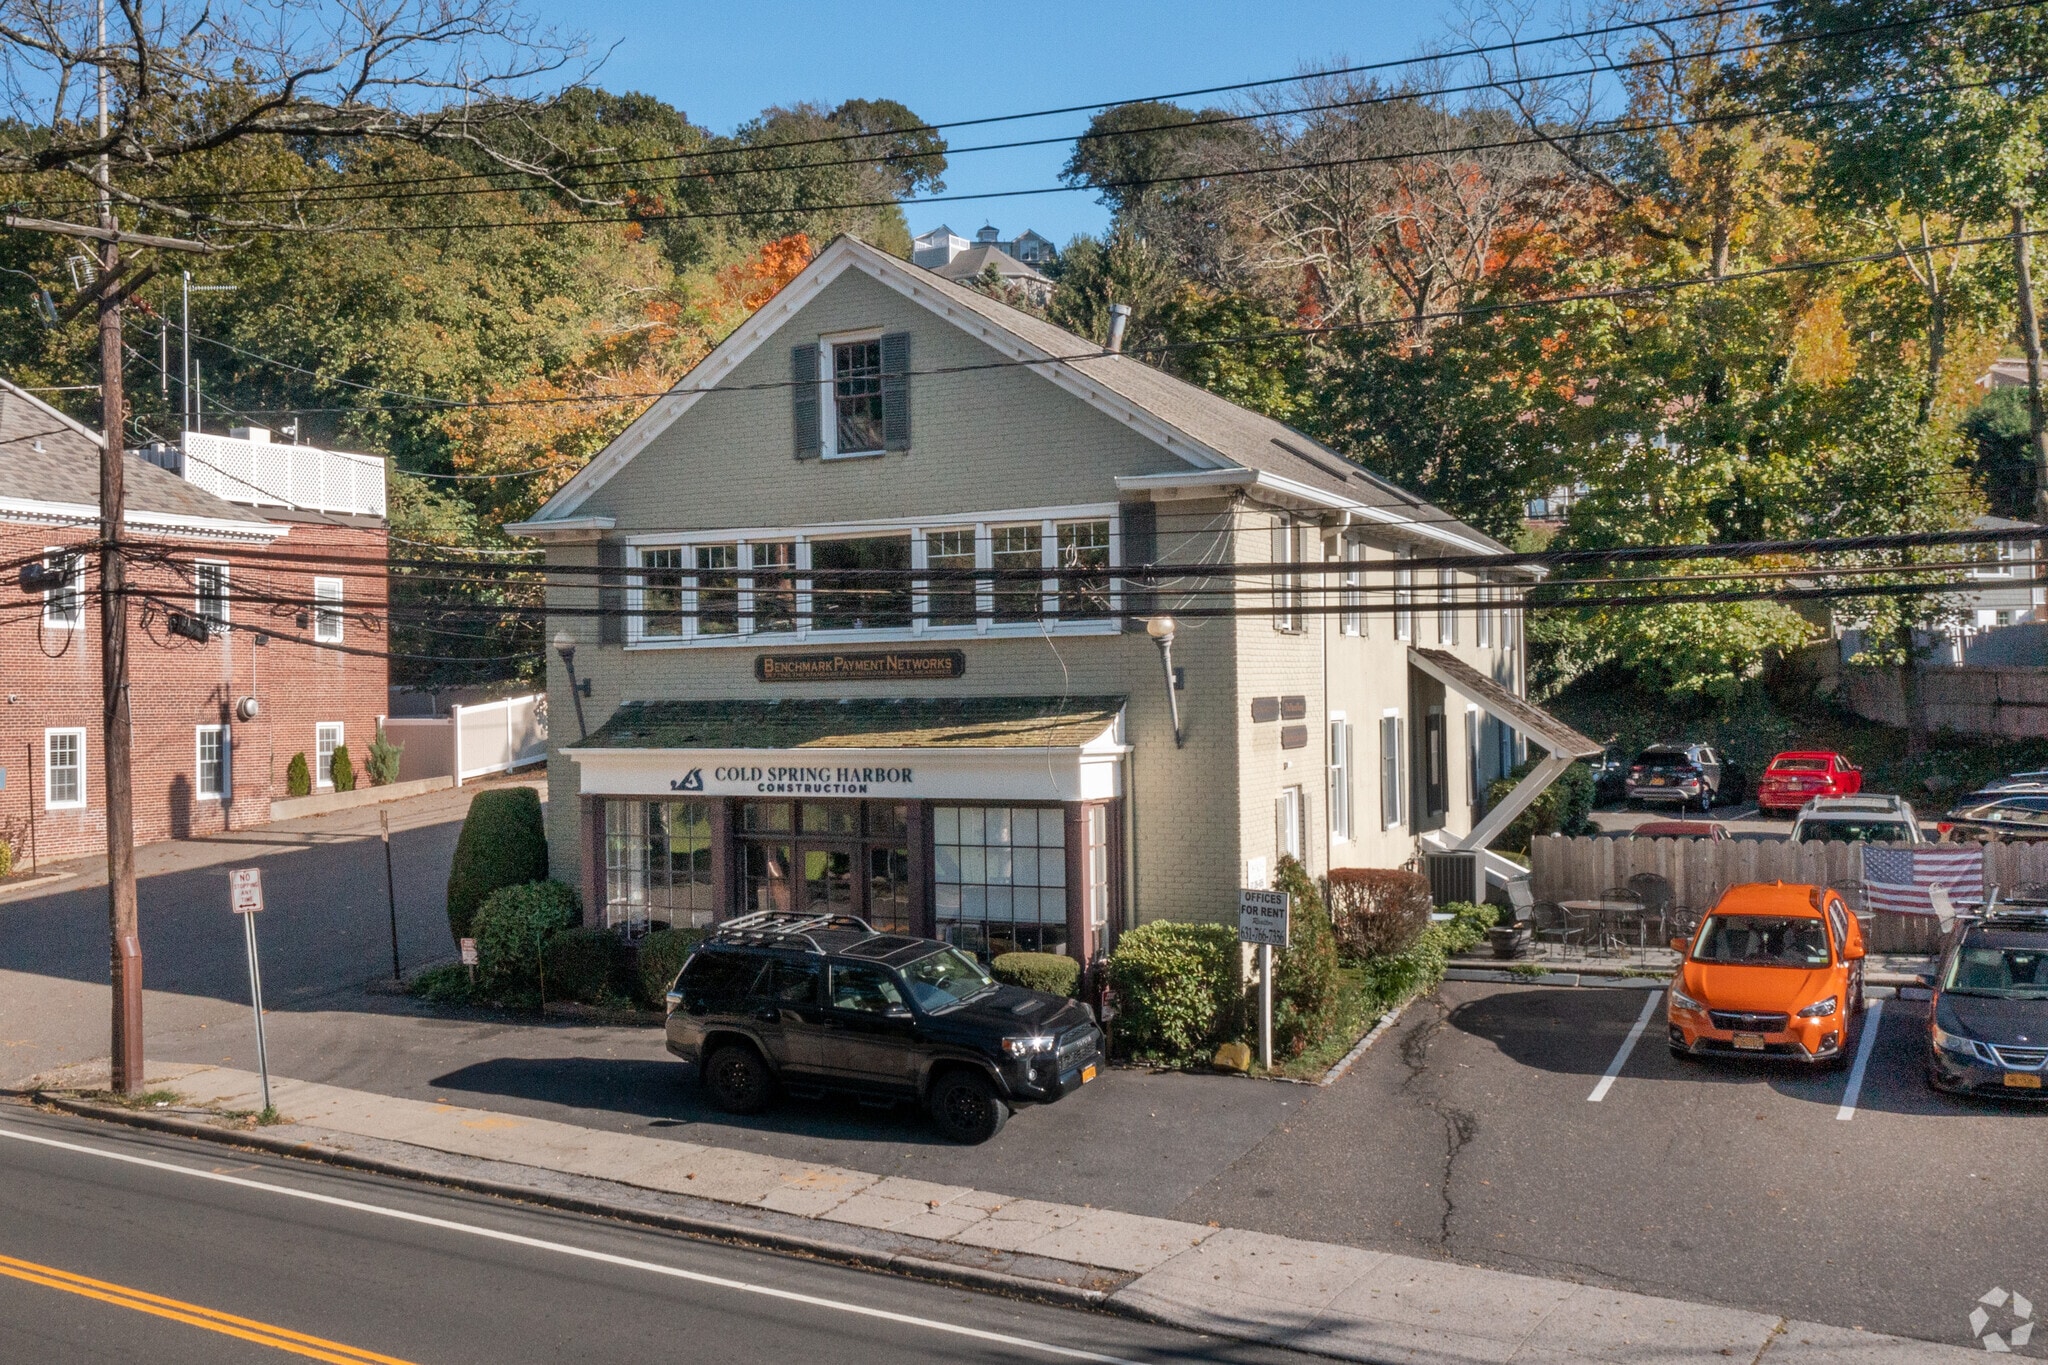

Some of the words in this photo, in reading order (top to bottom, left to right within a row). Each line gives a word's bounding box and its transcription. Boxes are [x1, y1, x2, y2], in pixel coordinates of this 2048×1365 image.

[715, 766, 762, 782] COLD
[768, 767, 830, 782] SPRING
[836, 768, 912, 783] HARBOR
[758, 783, 868, 794] CONSTRUCTION
[240, 873, 250, 881] NO
[1245, 892, 1282, 904] OFFICES
[1241, 904, 1258, 916] FOR
[1260, 906, 1284, 918] RENT
